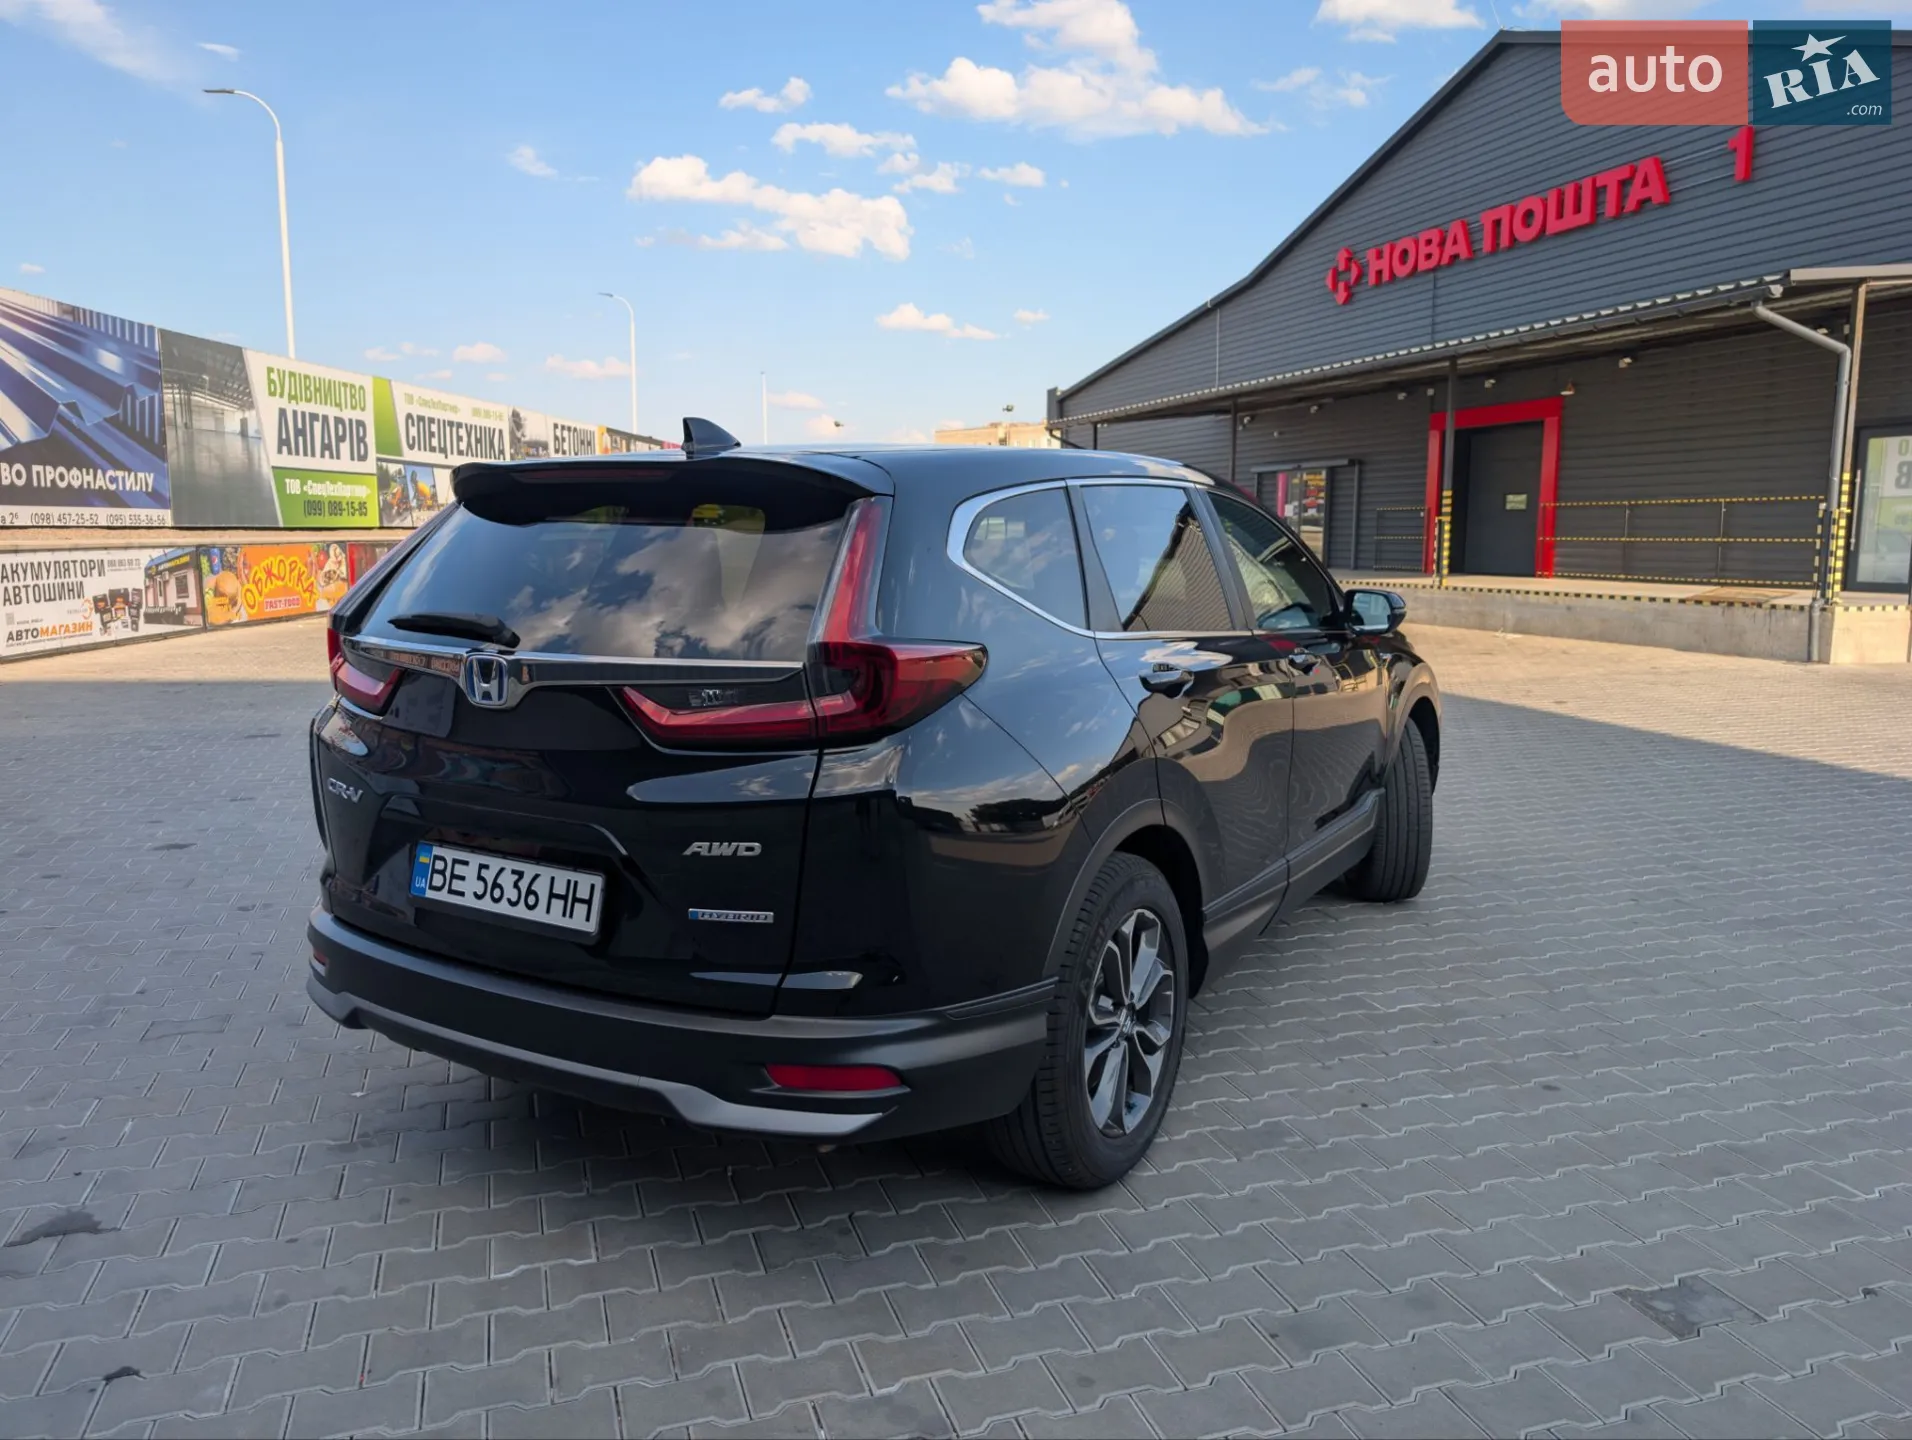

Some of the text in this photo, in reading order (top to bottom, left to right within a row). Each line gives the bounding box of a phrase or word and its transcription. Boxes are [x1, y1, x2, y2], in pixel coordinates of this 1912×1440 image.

[1366, 125, 1754, 286] НОВА ПОШТА 1
[266, 366, 366, 412] БУДІВНИЦТВО
[277, 407, 369, 462] АНГАРІВ
[405, 412, 506, 460] СПЕЦТЕХНІКА
[32, 464, 155, 492] ПРОФНАСТИЛУ
[30, 513, 54, 526] (098)
[57, 514, 99, 525] 457-25-52
[106, 514, 127, 526] (095)
[0, 558, 106, 584] АКУМУЛЯТОРИ
[243, 557, 318, 611] ОБЖОРКА
[3, 581, 85, 607] АВТОШИНИ
[6, 621, 93, 643] АВТОМАГАЗИН
[682, 842, 762, 856] AWD
[415, 876, 426, 889] UA
[428, 855, 595, 922] BE 5636 HH
